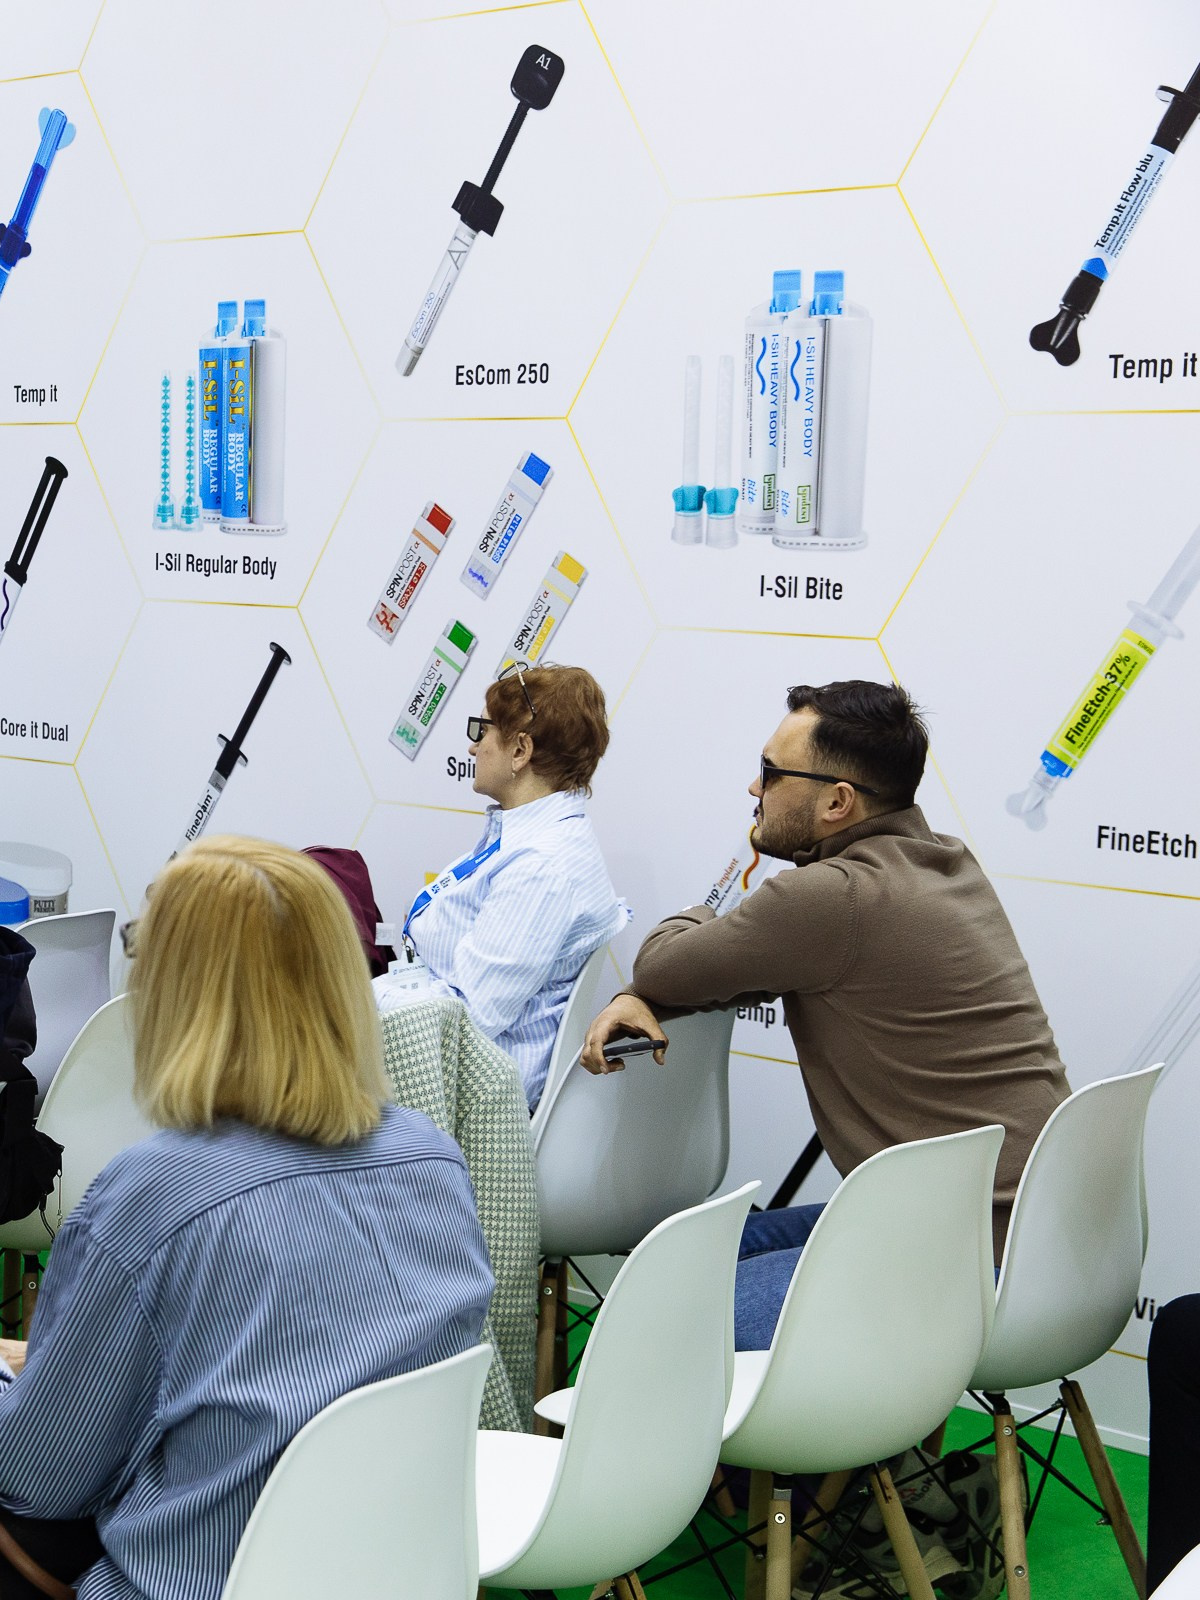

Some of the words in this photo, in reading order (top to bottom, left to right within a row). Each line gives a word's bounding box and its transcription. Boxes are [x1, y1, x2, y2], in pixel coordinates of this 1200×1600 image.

[536, 53, 551, 70] A1
[1093, 201, 1127, 250] Temp.It
[1119, 172, 1142, 203] Flow
[1135, 151, 1153, 173] blu
[447, 234, 472, 270] A1
[456, 364, 511, 386] EsCom
[517, 363, 549, 384] 250
[769, 362, 777, 405] HEAVY
[1109, 354, 1176, 383] Temp
[1183, 352, 1197, 378] it
[14, 385, 45, 406] Temp
[48, 384, 58, 403] it
[804, 367, 814, 412] HEAVY
[769, 410, 777, 447] BODY
[802, 418, 812, 456] BODY
[203, 429, 211, 468] BODY
[209, 429, 218, 493] REGULAR
[228, 433, 237, 474] BODY
[235, 433, 245, 502] REGULAR
[747, 479, 756, 504] Bite
[780, 490, 789, 516] Bite
[479, 527, 497, 553] SPIN
[493, 498, 512, 528] POST
[155, 552, 181, 573] I-Sil
[186, 554, 238, 577] Regular
[242, 556, 277, 579] Body
[386, 573, 404, 599] SPIN
[399, 546, 418, 574] POST
[760, 575, 797, 599] I-Sil
[805, 577, 843, 600] Bite
[514, 625, 532, 651] SPIN
[527, 595, 547, 626] POST
[408, 690, 426, 715] SPIN
[421, 663, 439, 692] POST
[1064, 653, 1131, 745] FineEtch-37%
[0, 718, 27, 738] Core
[30, 720, 39, 739] it
[42, 722, 69, 742] Dual
[447, 756, 476, 781] Spi
[1097, 825, 1197, 859] FineEtch
[737, 1006, 776, 1028] emp
